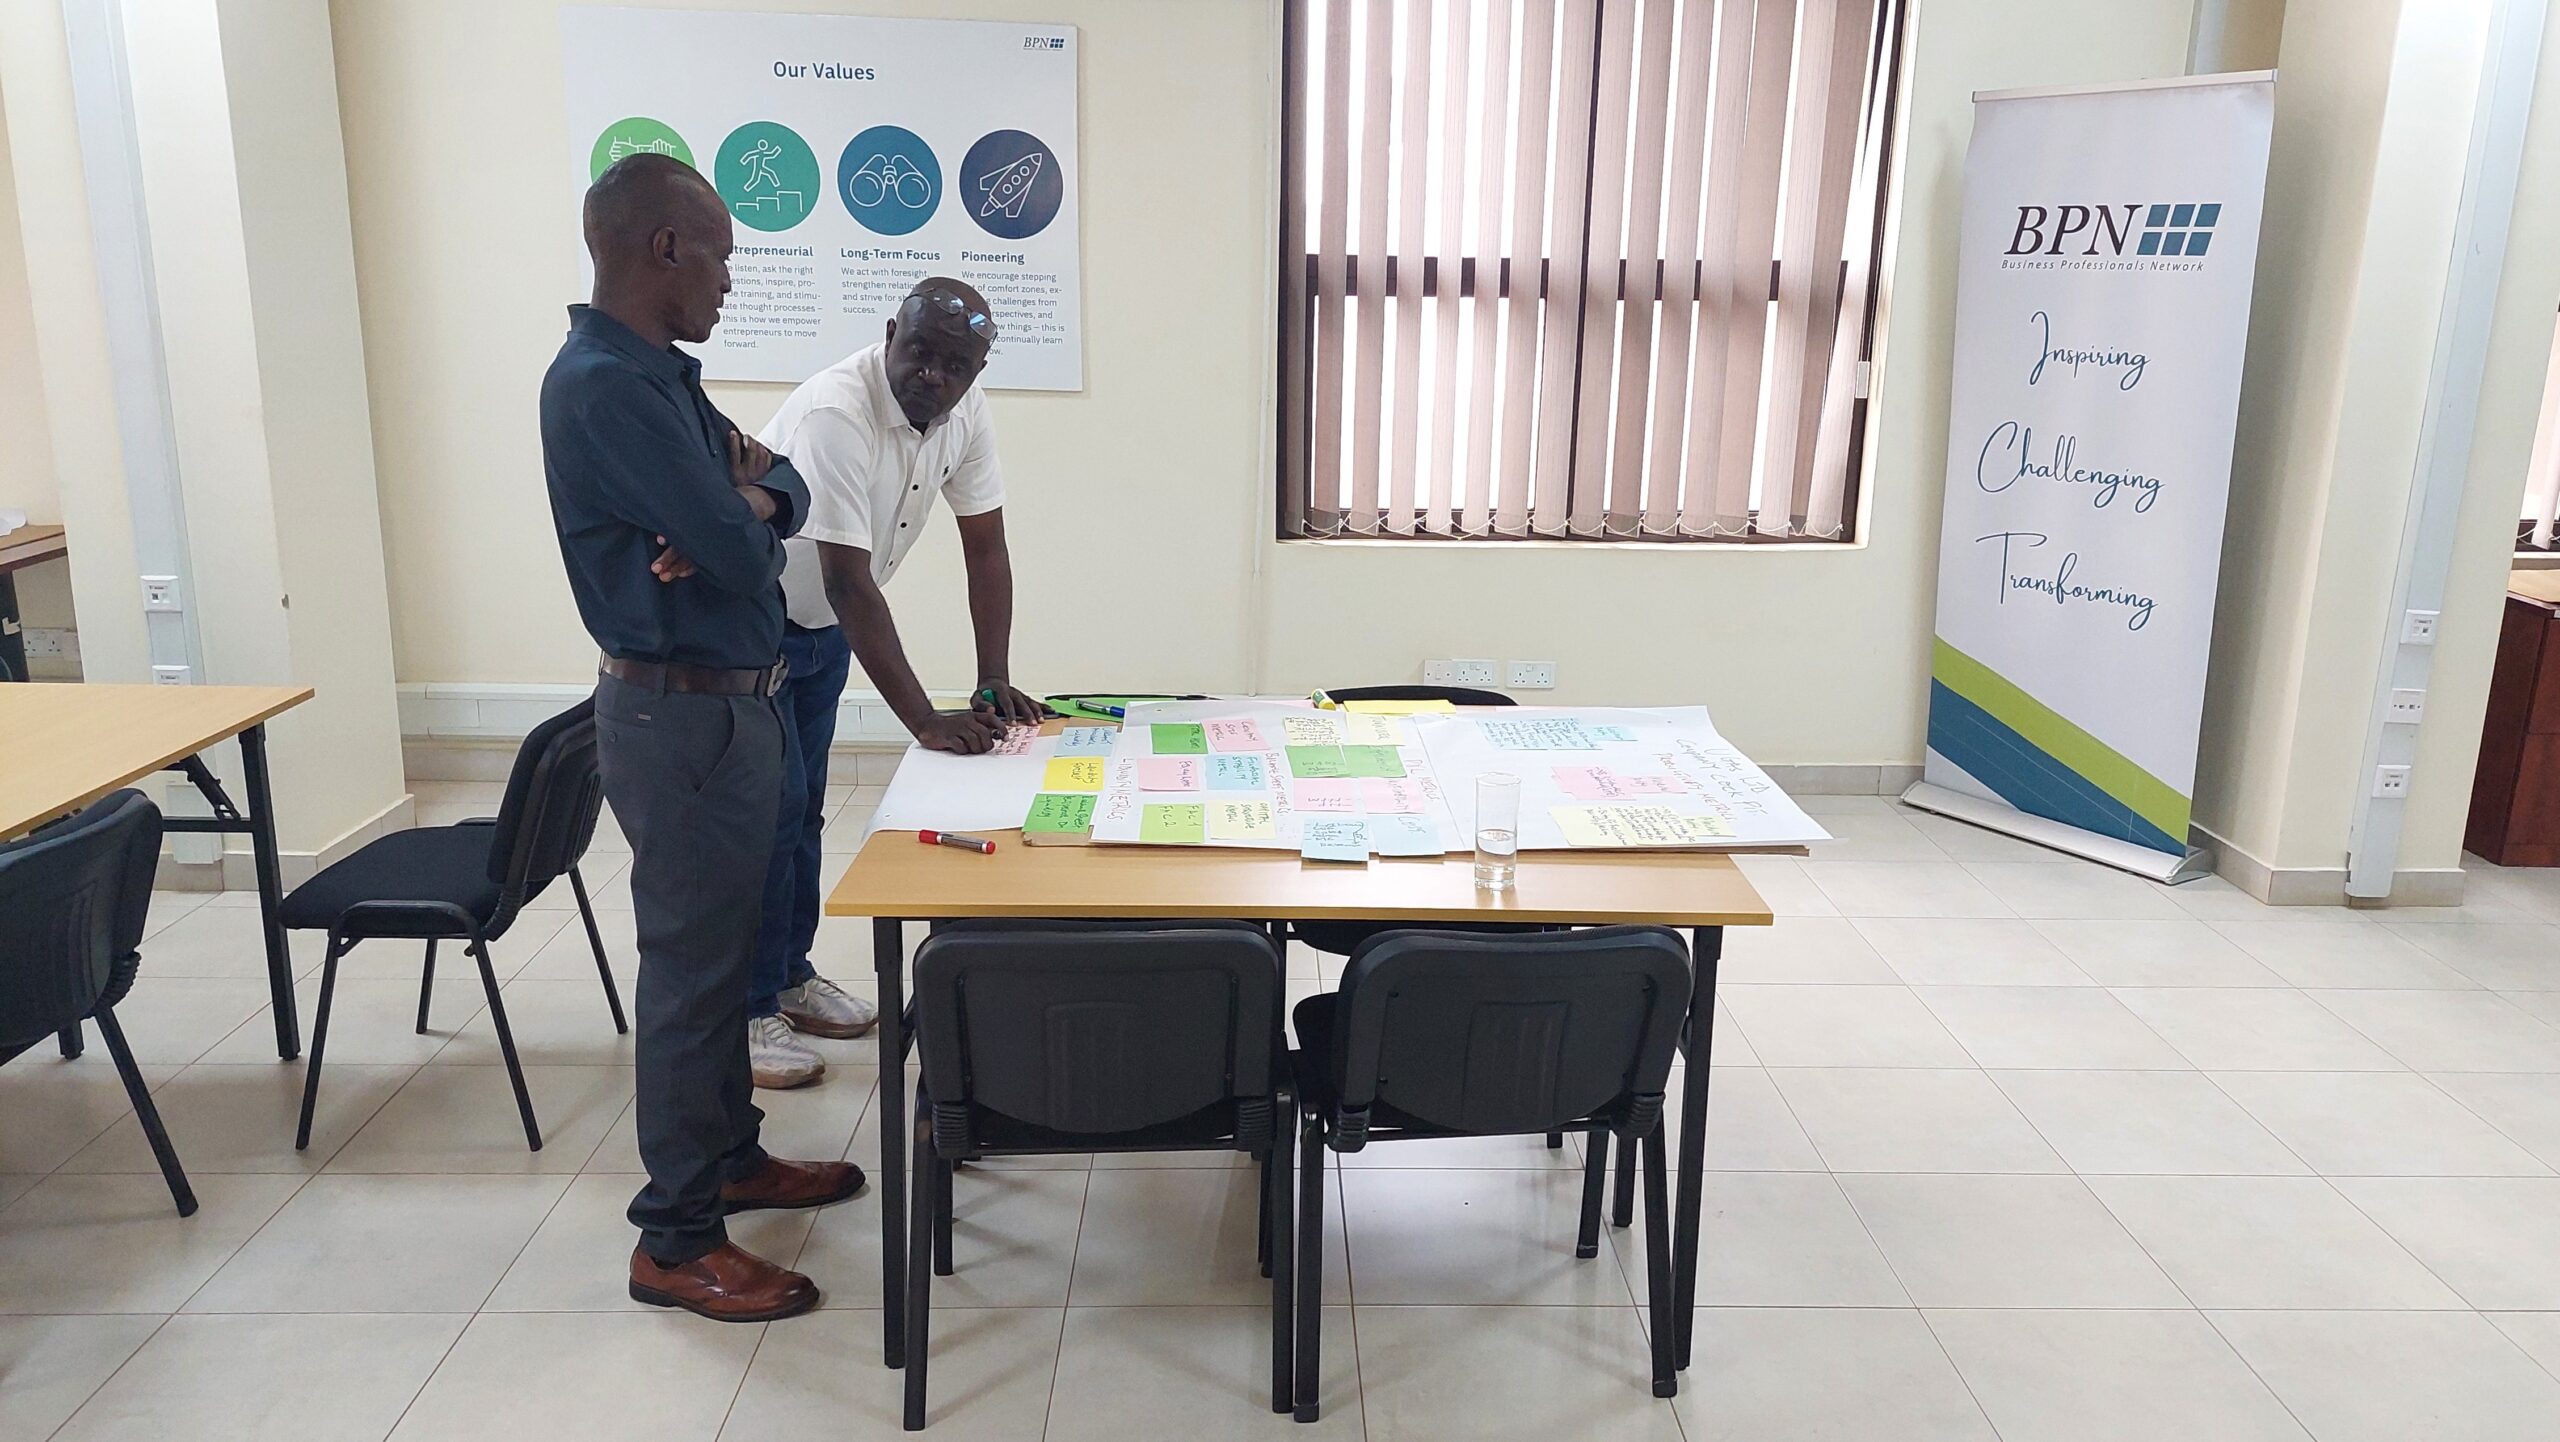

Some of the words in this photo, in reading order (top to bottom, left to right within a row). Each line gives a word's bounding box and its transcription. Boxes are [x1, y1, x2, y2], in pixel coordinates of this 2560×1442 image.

[1024, 37, 1050, 48] BPN
[773, 61, 807, 78] Our
[812, 62, 875, 80] Values
[2004, 204, 2143, 256] BPN
[734, 244, 814, 257] trepreneurial
[841, 248, 903, 260] Long-Term
[906, 250, 940, 261] Focus
[961, 251, 1025, 265] Pioneering
[735, 264, 760, 274] listen,
[762, 265, 777, 273] ask
[779, 266, 793, 274] the
[794, 267, 813, 276] right
[2001, 259, 2054, 269] Business
[2060, 259, 2144, 271] Professionals
[2150, 261, 2204, 272] Network
[841, 267, 854, 276] We
[856, 268, 869, 276] act
[871, 268, 889, 277] with
[961, 271, 975, 279] We
[976, 271, 1019, 281] encourage
[1021, 272, 1057, 282] stepping
[731, 277, 763, 287] estions,
[765, 278, 796, 288] inspire,
[798, 280, 816, 288] pro-
[842, 281, 887, 290] strengthen
[978, 284, 986, 292] of
[987, 284, 1020, 293] comfort
[1021, 286, 1048, 294] zones,
[741, 290, 774, 300] training,
[776, 291, 792, 299] and
[794, 291, 821, 300] stimu-
[842, 293, 858, 301] and
[860, 293, 882, 301] strive
[884, 294, 896, 302] for
[740, 303, 772, 312] thought
[992, 298, 1036, 307] challenges
[1038, 298, 1057, 306] from
[843, 306, 878, 314] success.
[1037, 311, 1053, 319] and
[722, 315, 738, 323] this
[740, 315, 747, 323] is
[749, 315, 767, 323] how
[782, 318, 821, 326] empower
[723, 328, 782, 337] entrepreneurs
[784, 329, 793, 337] to
[1007, 323, 1032, 332] things
[1041, 324, 1056, 332] this
[1059, 324, 1065, 332] is
[724, 340, 758, 348] forward.
[996, 336, 1041, 345] continually
[1042, 336, 1063, 344] learn
[2029, 311, 2152, 391] Inspiring
[1977, 421, 2166, 513] Challenging
[1975, 531, 2158, 631] Transforming
